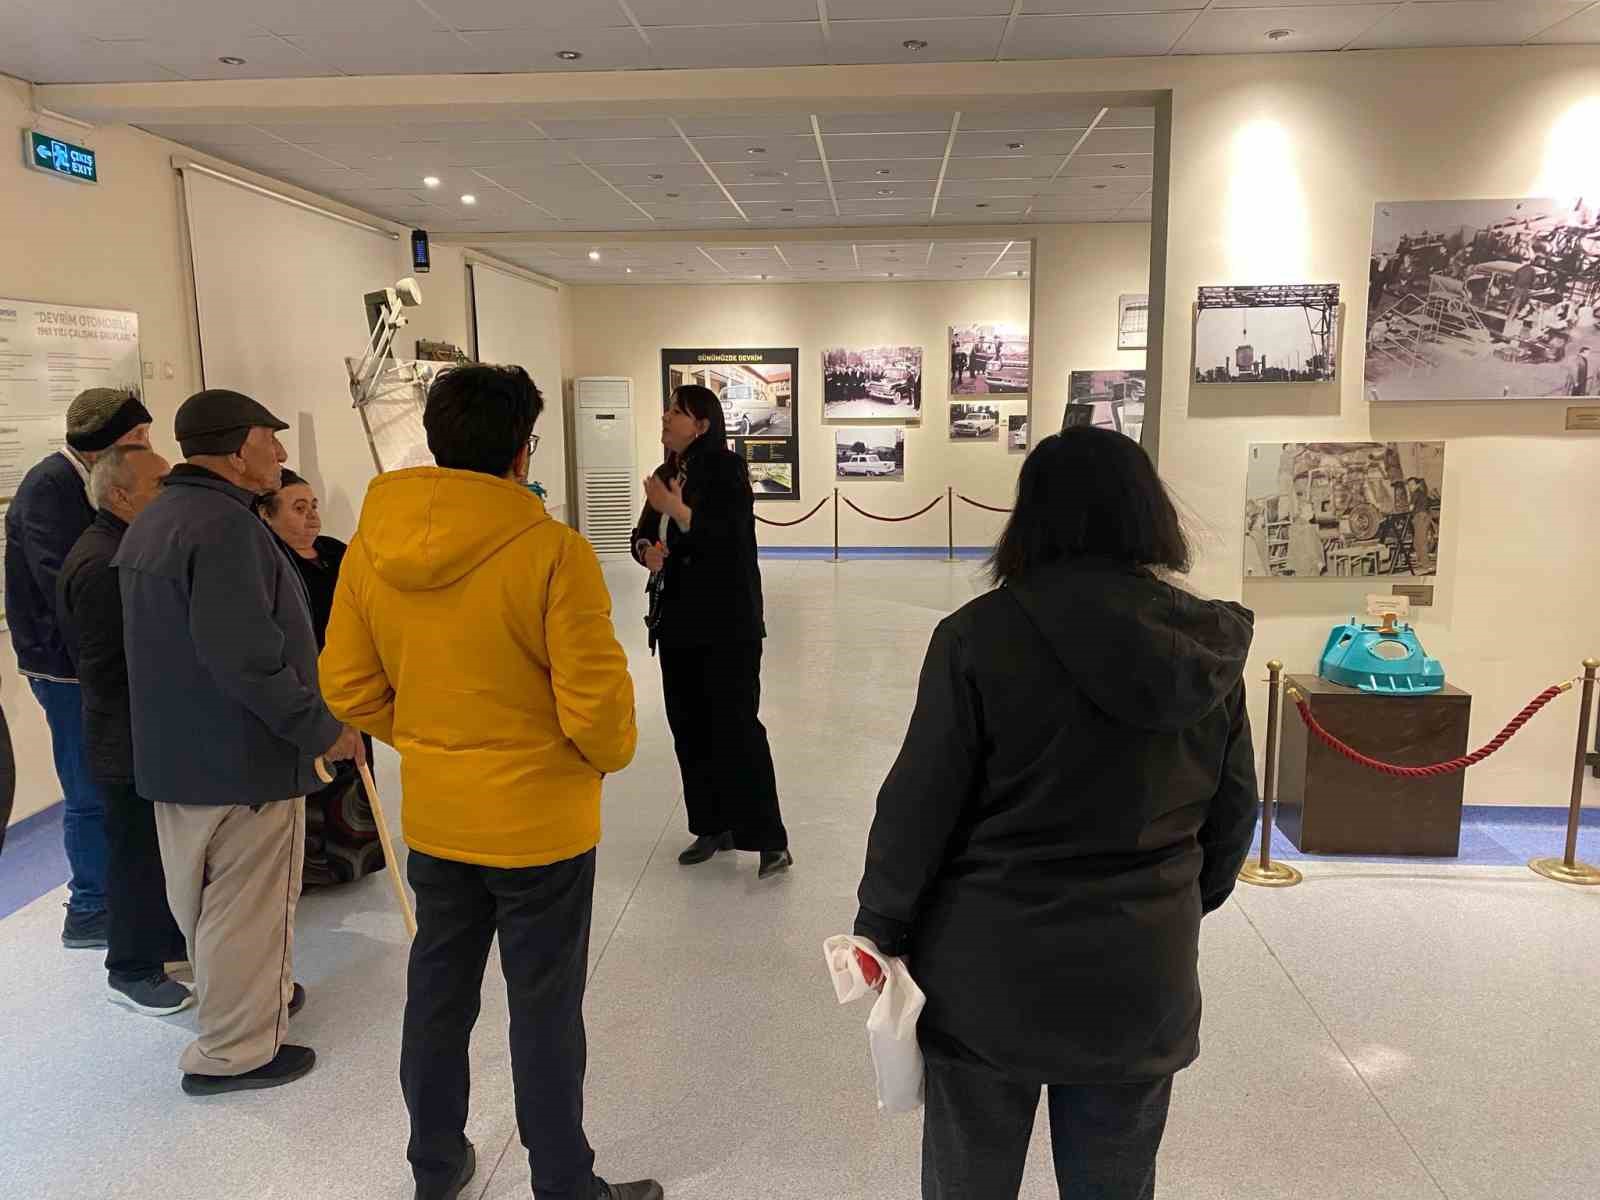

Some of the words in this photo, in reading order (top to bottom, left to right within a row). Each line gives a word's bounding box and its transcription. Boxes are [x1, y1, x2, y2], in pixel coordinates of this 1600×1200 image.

[71, 150, 93, 166] ÇIKIŞ
[71, 162, 93, 176] EXIT
[738, 352, 763, 361] DEVRİM
